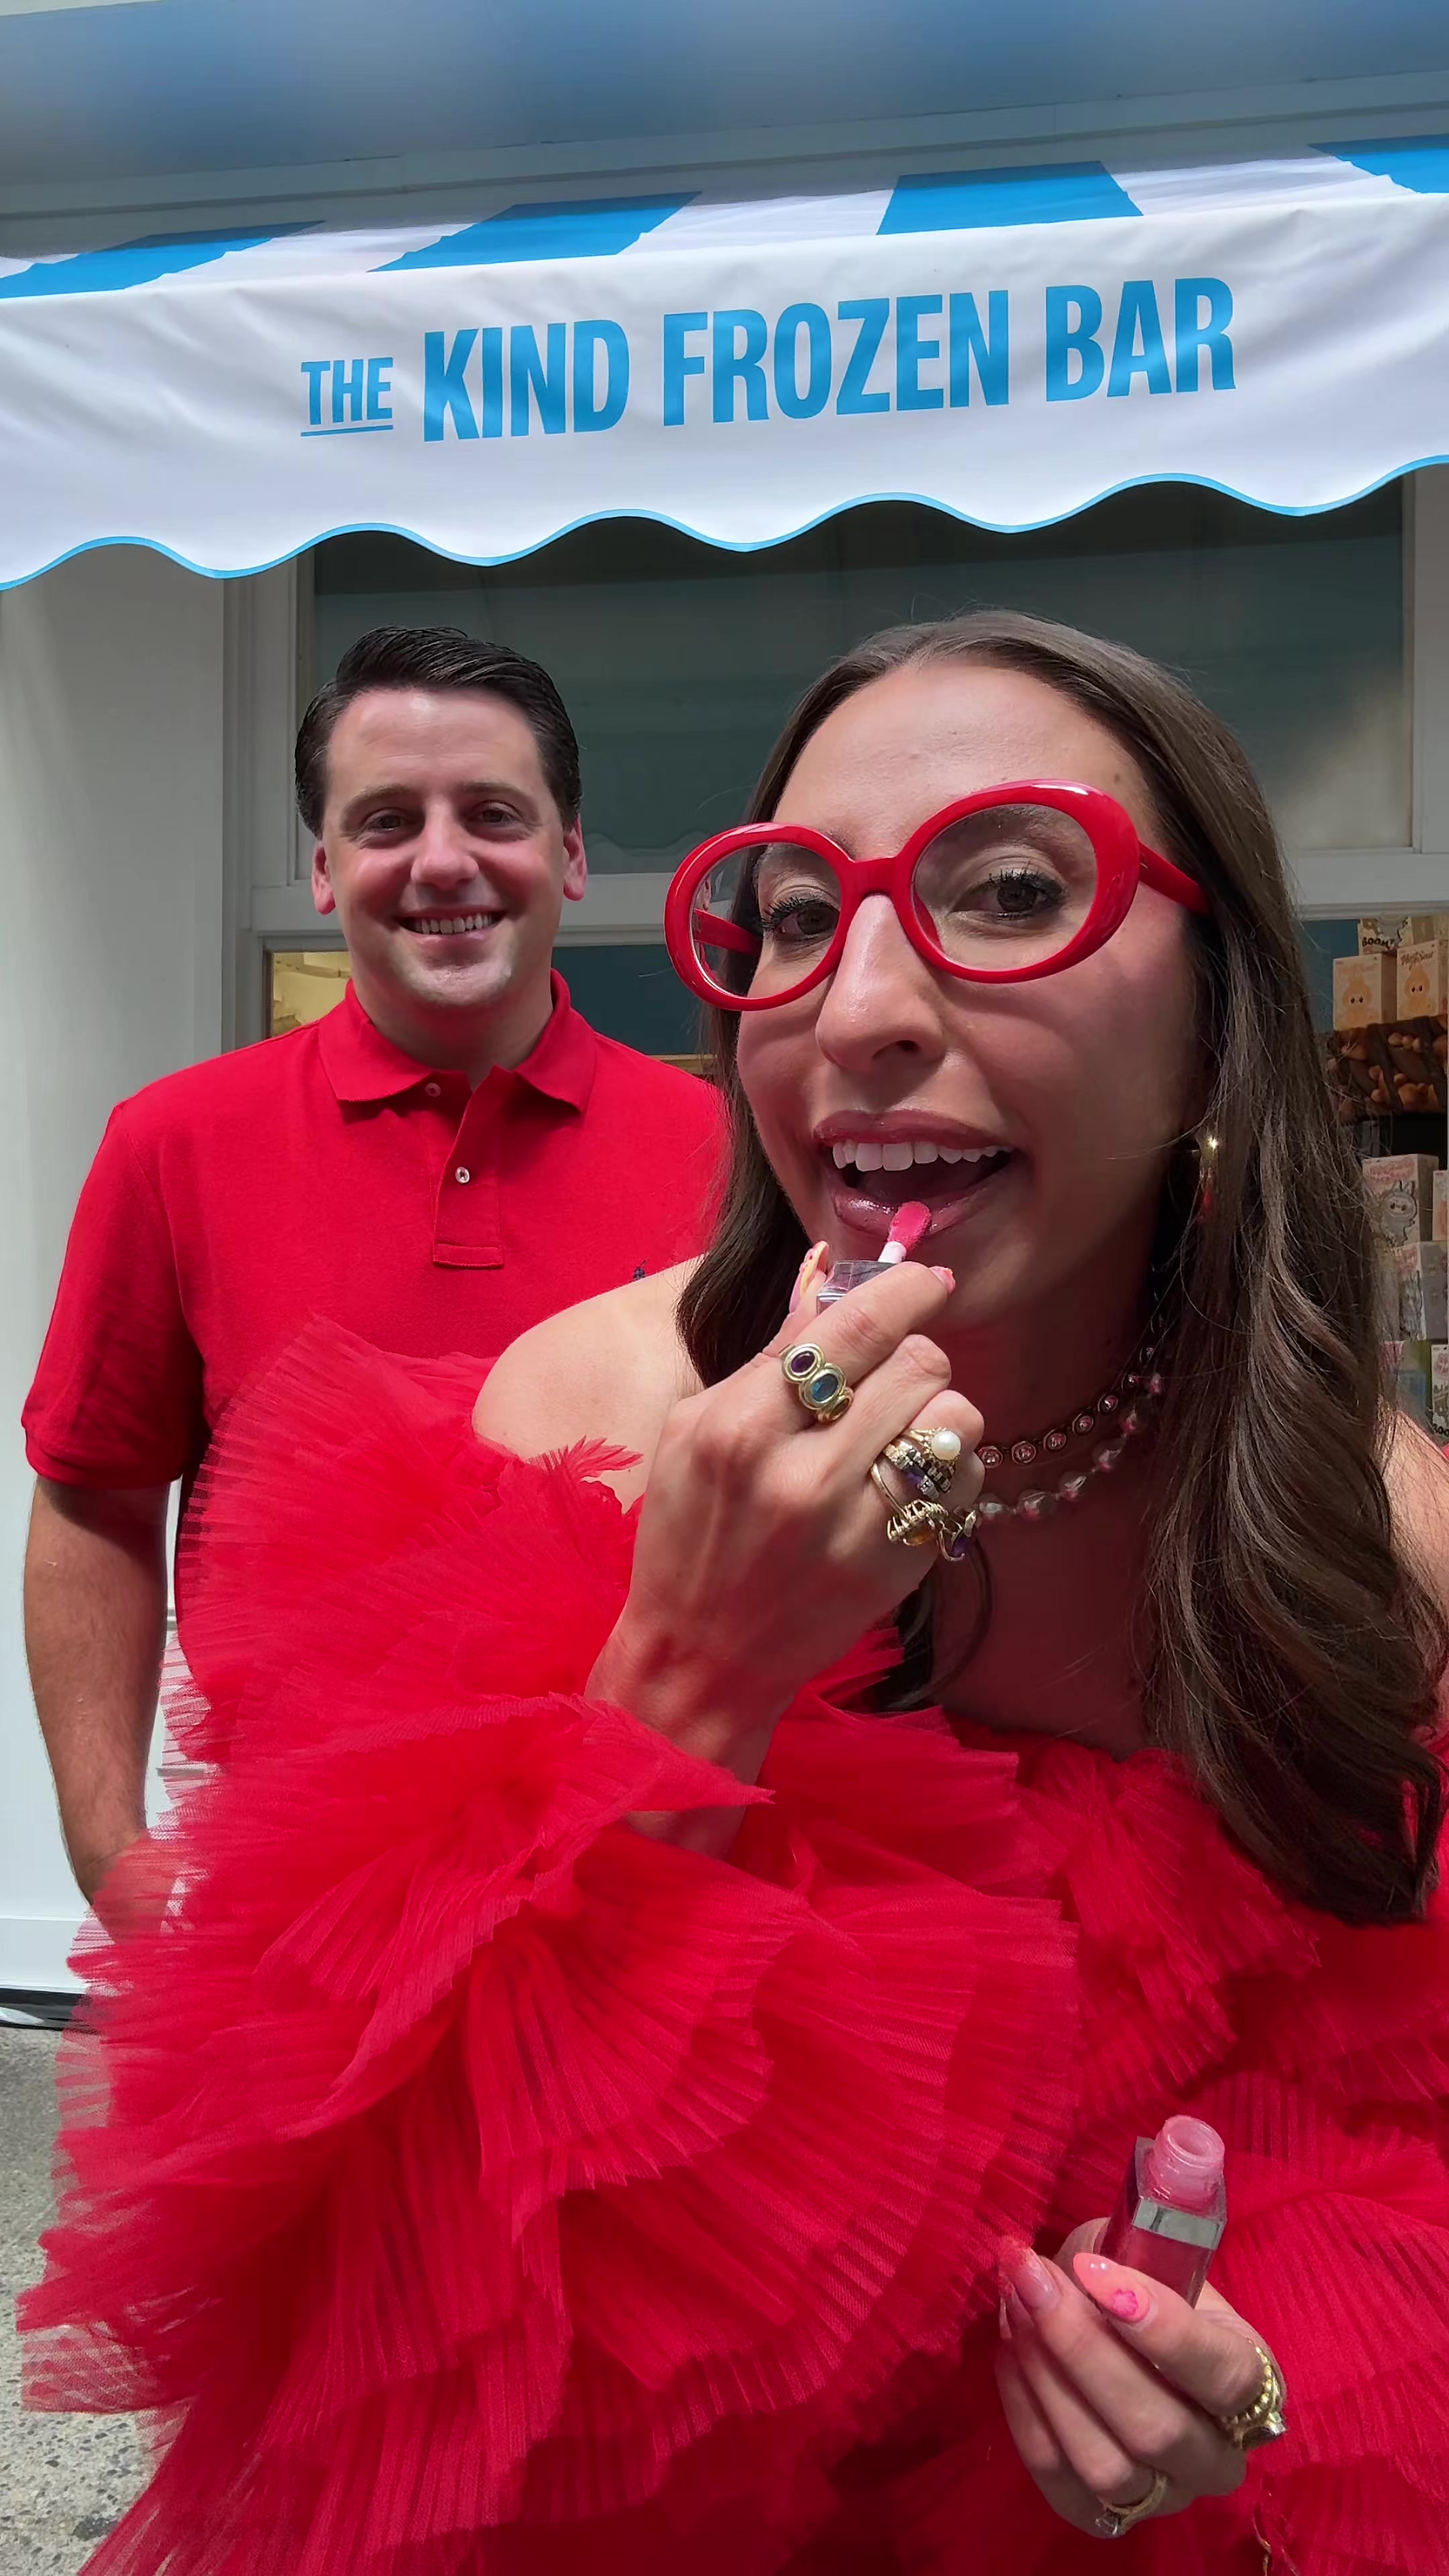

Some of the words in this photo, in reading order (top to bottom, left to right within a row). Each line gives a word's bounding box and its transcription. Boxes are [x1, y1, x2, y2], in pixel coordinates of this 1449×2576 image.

[301, 357, 394, 425] THE
[423, 319, 630, 442] KIND
[663, 290, 1010, 427] FROZEN
[1046, 277, 1236, 402] BAR
